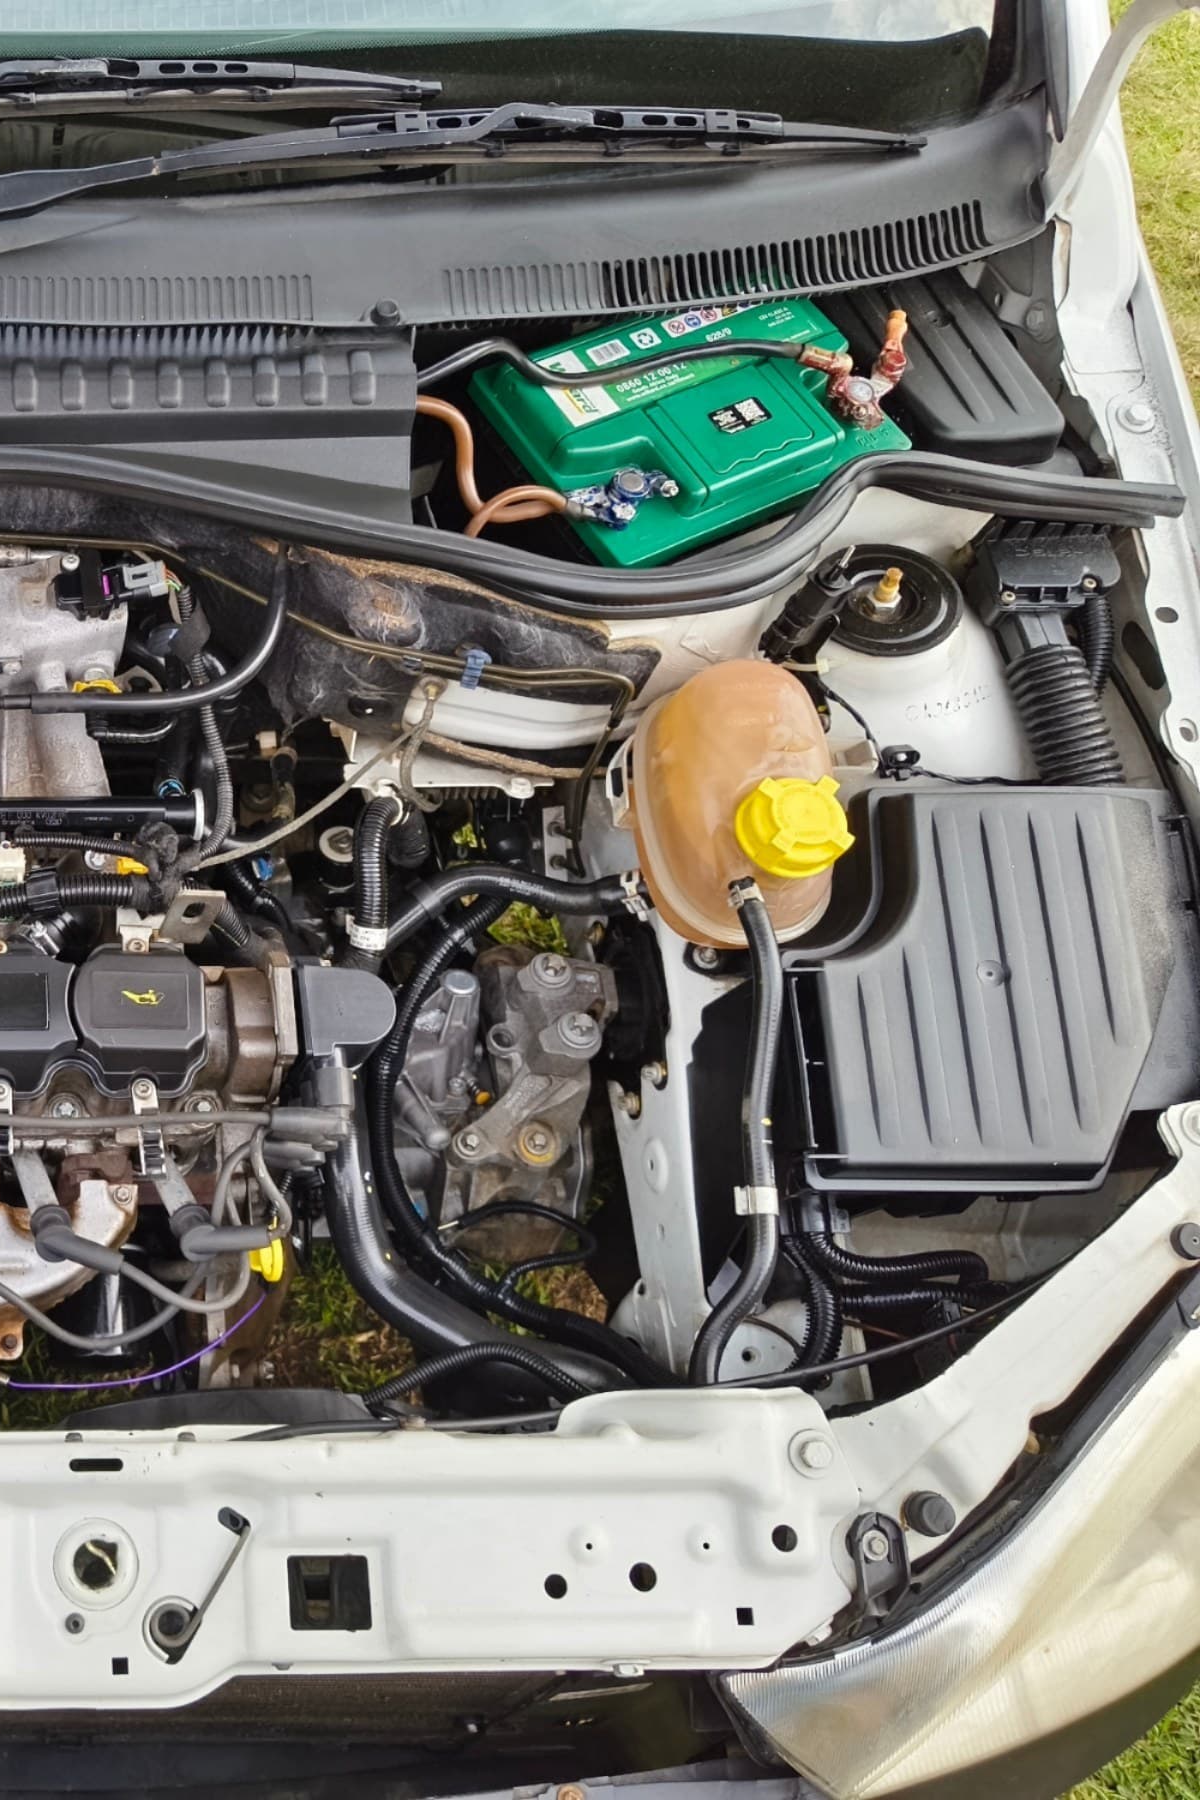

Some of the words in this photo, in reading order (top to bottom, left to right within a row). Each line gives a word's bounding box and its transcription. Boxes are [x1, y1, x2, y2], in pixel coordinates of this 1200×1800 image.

[615, 378, 642, 393] 0860
[643, 371, 657, 382] 12
[657, 366, 672, 377] 00
